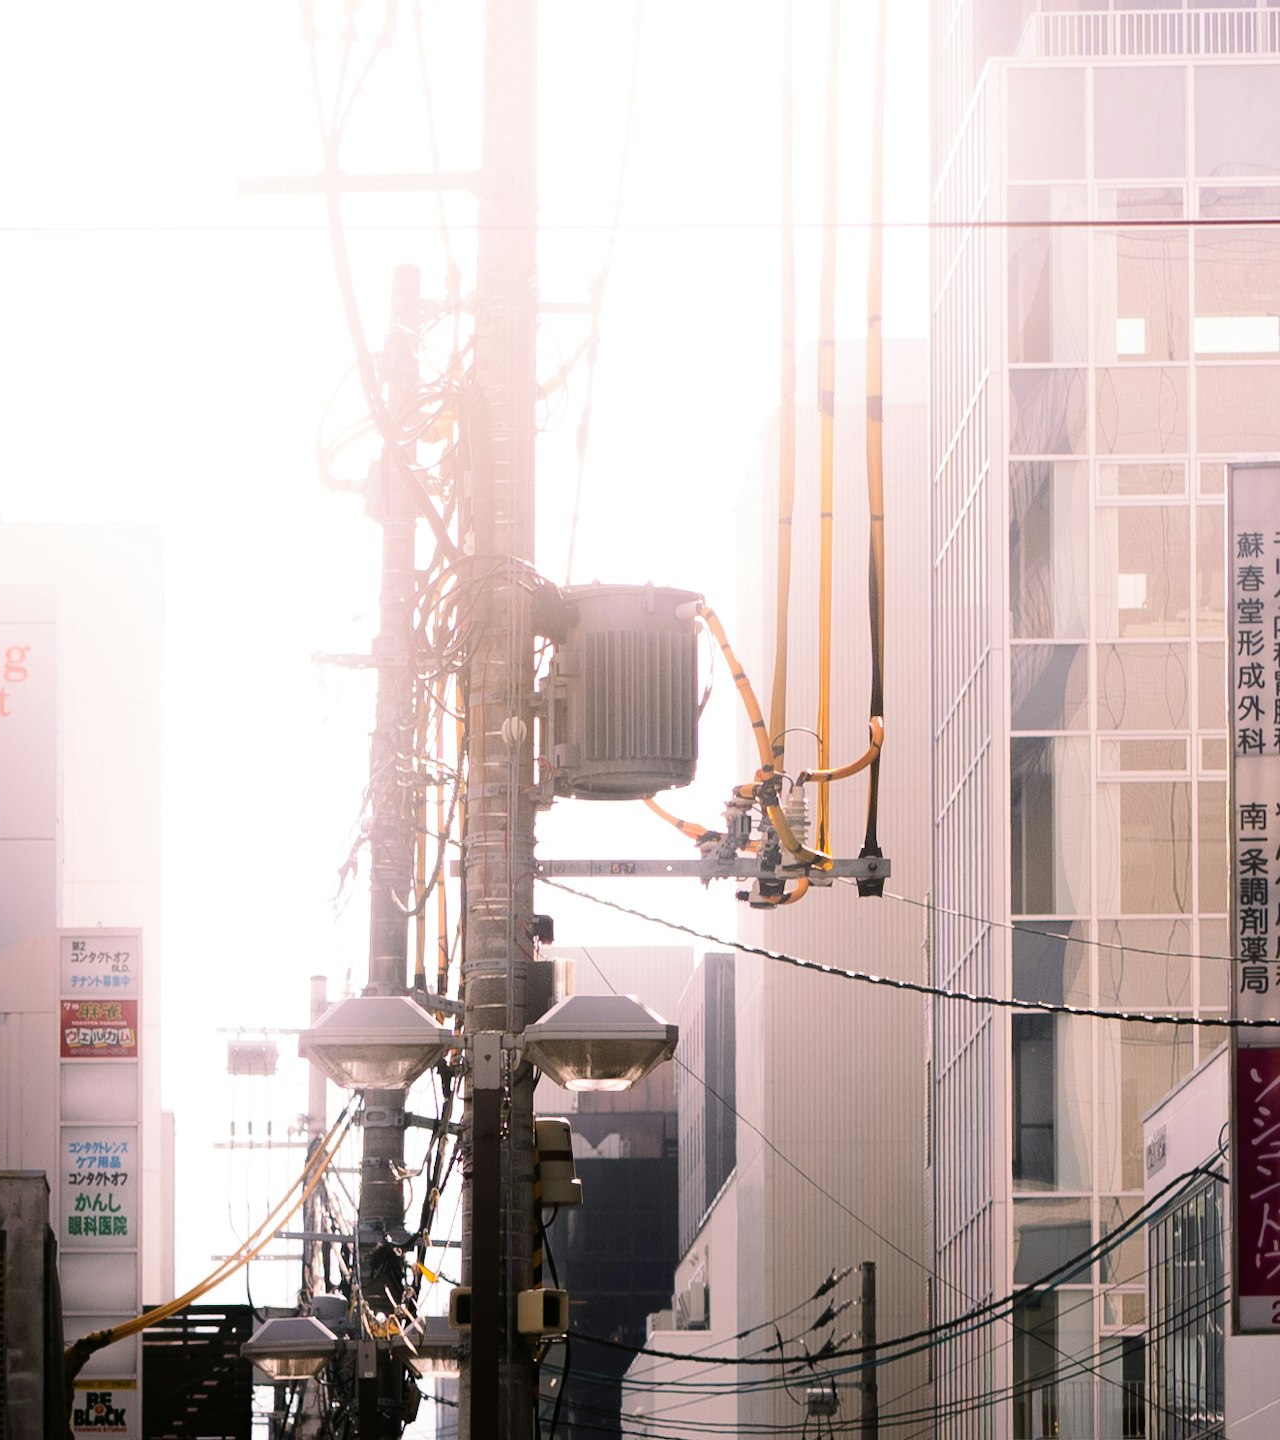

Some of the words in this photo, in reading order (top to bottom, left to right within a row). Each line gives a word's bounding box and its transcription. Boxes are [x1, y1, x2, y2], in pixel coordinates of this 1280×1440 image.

[1236, 531, 1266, 754] 蘇春堂形成外科
[1239, 802, 1269, 995] 南一条調剤薬局
[70, 952, 131, 964] コンタクトオフ
[70, 975, 132, 988] テナント募集中
[65, 1028, 132, 1045] ウェルカム
[68, 1141, 129, 1154] コンタクトレンズ
[76, 1155, 122, 1169] ケア用品
[68, 1171, 128, 1186] コンタクトオフ
[74, 1192, 122, 1212] かんし
[68, 1215, 128, 1236] 眼科医院
[86, 1392, 112, 1411] BE
[73, 1408, 127, 1427] BLACK
